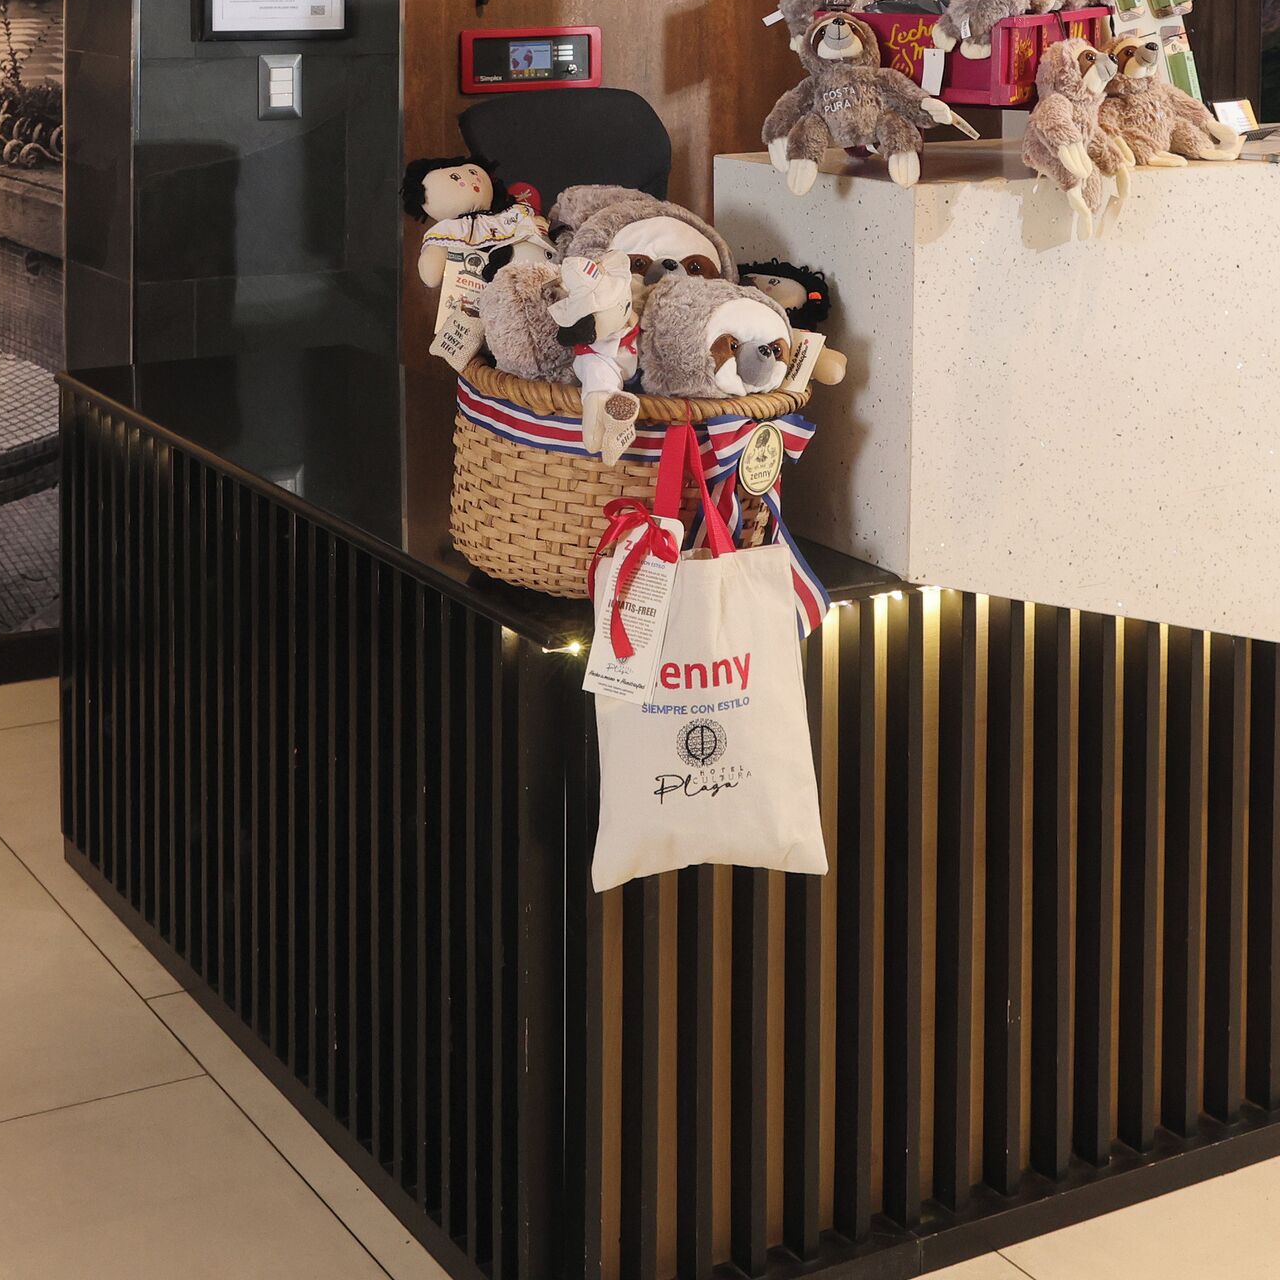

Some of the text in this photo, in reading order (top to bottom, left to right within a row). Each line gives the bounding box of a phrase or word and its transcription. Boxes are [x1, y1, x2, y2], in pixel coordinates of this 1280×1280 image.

[823, 86, 856, 102] COSTA
[824, 99, 852, 114] PURA
[453, 319, 471, 336] CAFÉ
[454, 328, 464, 340] DE
[440, 340, 457, 357] RICA
[443, 331, 465, 351] COSTA
[620, 430, 634, 447] RICA
[750, 469, 773, 481] zenny
[654, 652, 751, 691] enny
[641, 696, 751, 715] SIEMPRE CON ESTILO
[692, 770, 753, 786] CULTURA
[699, 765, 744, 776] HOTEL
